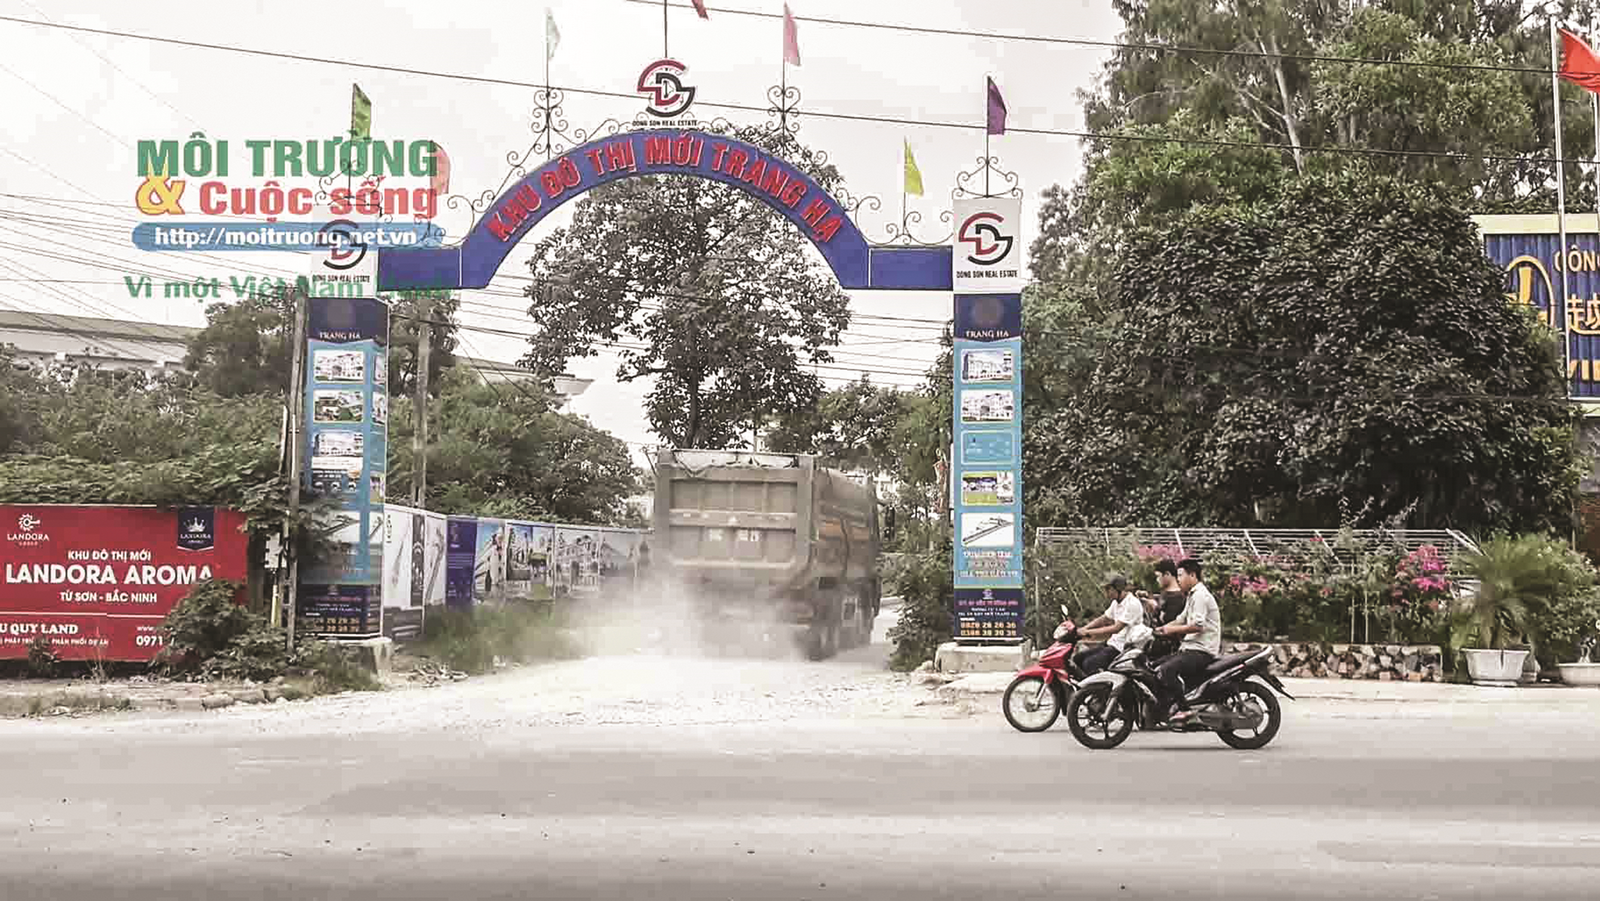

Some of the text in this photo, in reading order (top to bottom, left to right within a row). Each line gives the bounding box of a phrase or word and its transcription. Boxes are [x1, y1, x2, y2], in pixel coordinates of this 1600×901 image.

[485, 182, 543, 243] KHU
[586, 136, 637, 175] THỊ
[645, 131, 704, 169] MỚI
[711, 143, 810, 210] TRANG
[1555, 244, 1600, 273] CÔN
[985, 270, 998, 278] REAL
[1000, 270, 1018, 278] ESTATE
[7, 533, 50, 542] LANDORA
[67, 548, 152, 563] KHU ĐÔ THỊ MỚI
[6, 563, 213, 585] LANDORA AROMA
[74, 590, 97, 602] SƠN
[131, 592, 158, 604] NINH
[10, 623, 38, 636] QUY
[40, 623, 79, 635] LAND
[136, 635, 164, 647] 0971
